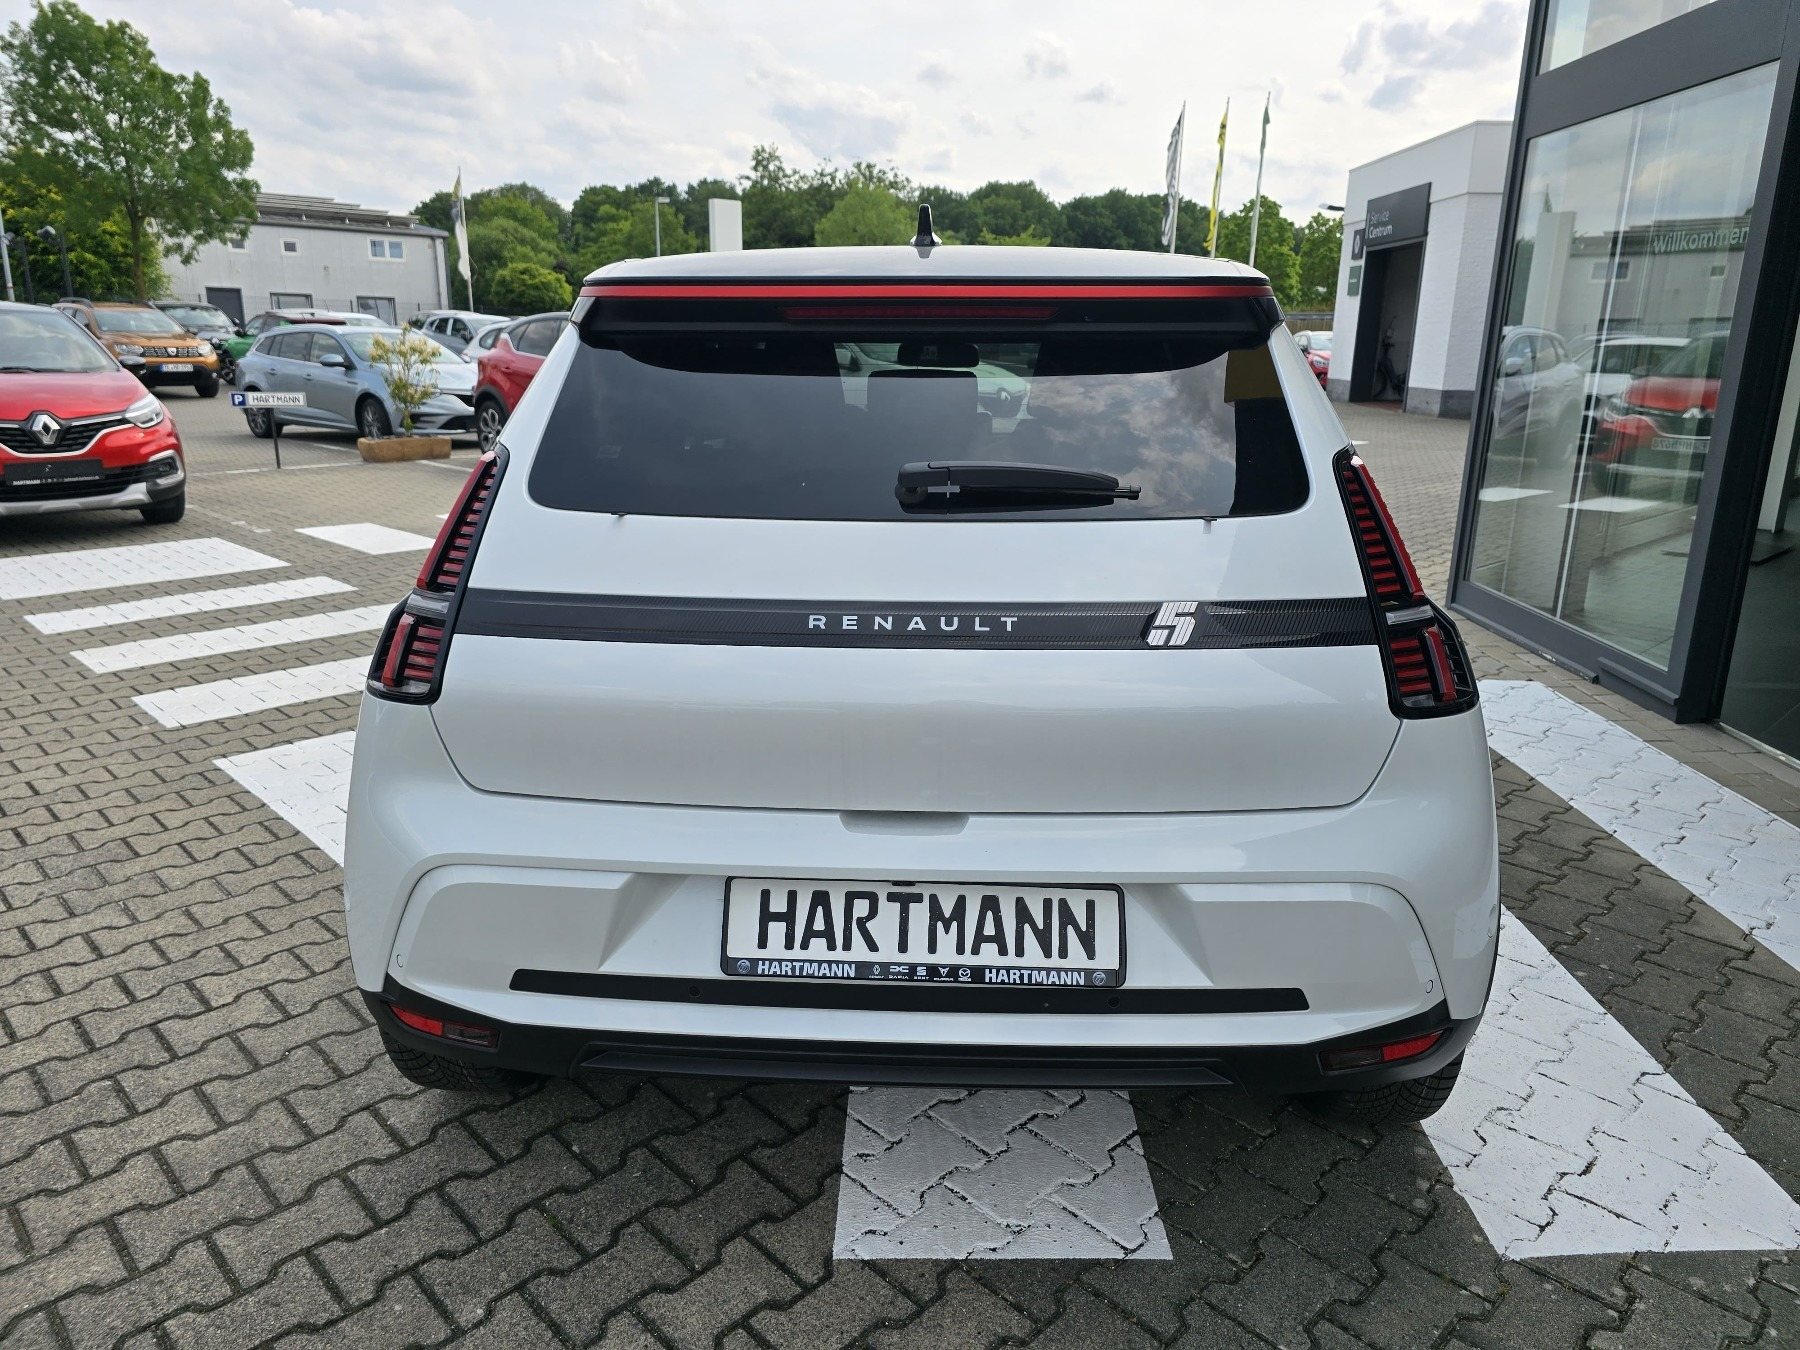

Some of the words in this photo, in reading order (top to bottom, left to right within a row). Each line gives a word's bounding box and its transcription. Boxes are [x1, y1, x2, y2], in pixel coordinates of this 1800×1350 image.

[1370, 210, 1390, 225] Service
[1368, 225, 1393, 239] Centrum
[233, 394, 243, 405] P
[252, 394, 301, 404] HARTMANN
[808, 614, 1018, 632] RENAULT
[1146, 601, 1199, 647] 5
[757, 888, 1096, 961] HARTMANN
[757, 960, 856, 978] HARTMANN
[984, 968, 1085, 986] HARTMANN
